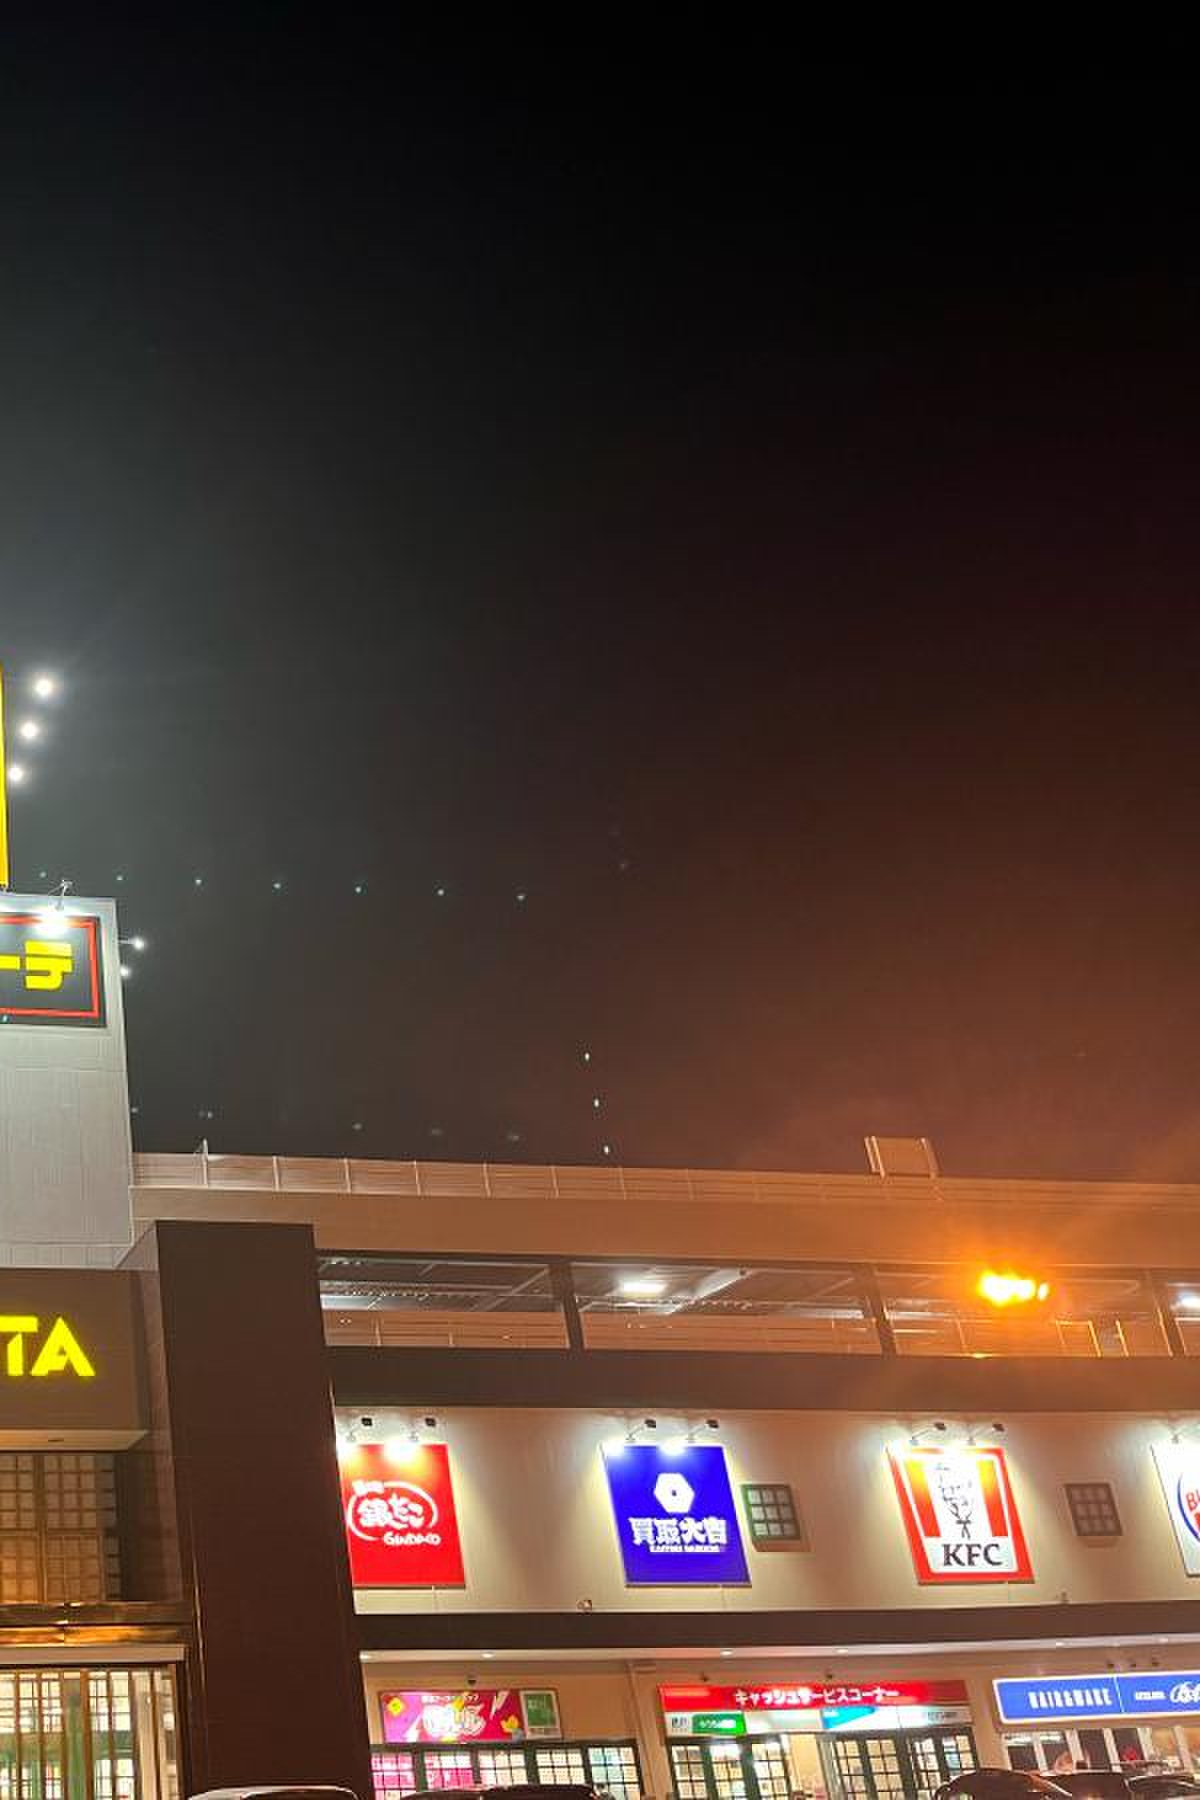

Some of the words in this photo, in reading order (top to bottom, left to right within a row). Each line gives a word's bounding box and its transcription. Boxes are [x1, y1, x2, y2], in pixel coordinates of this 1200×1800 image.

[942, 1543, 1003, 1567] KFC
[734, 1686, 899, 1707] キャッシュサービスコーナー
